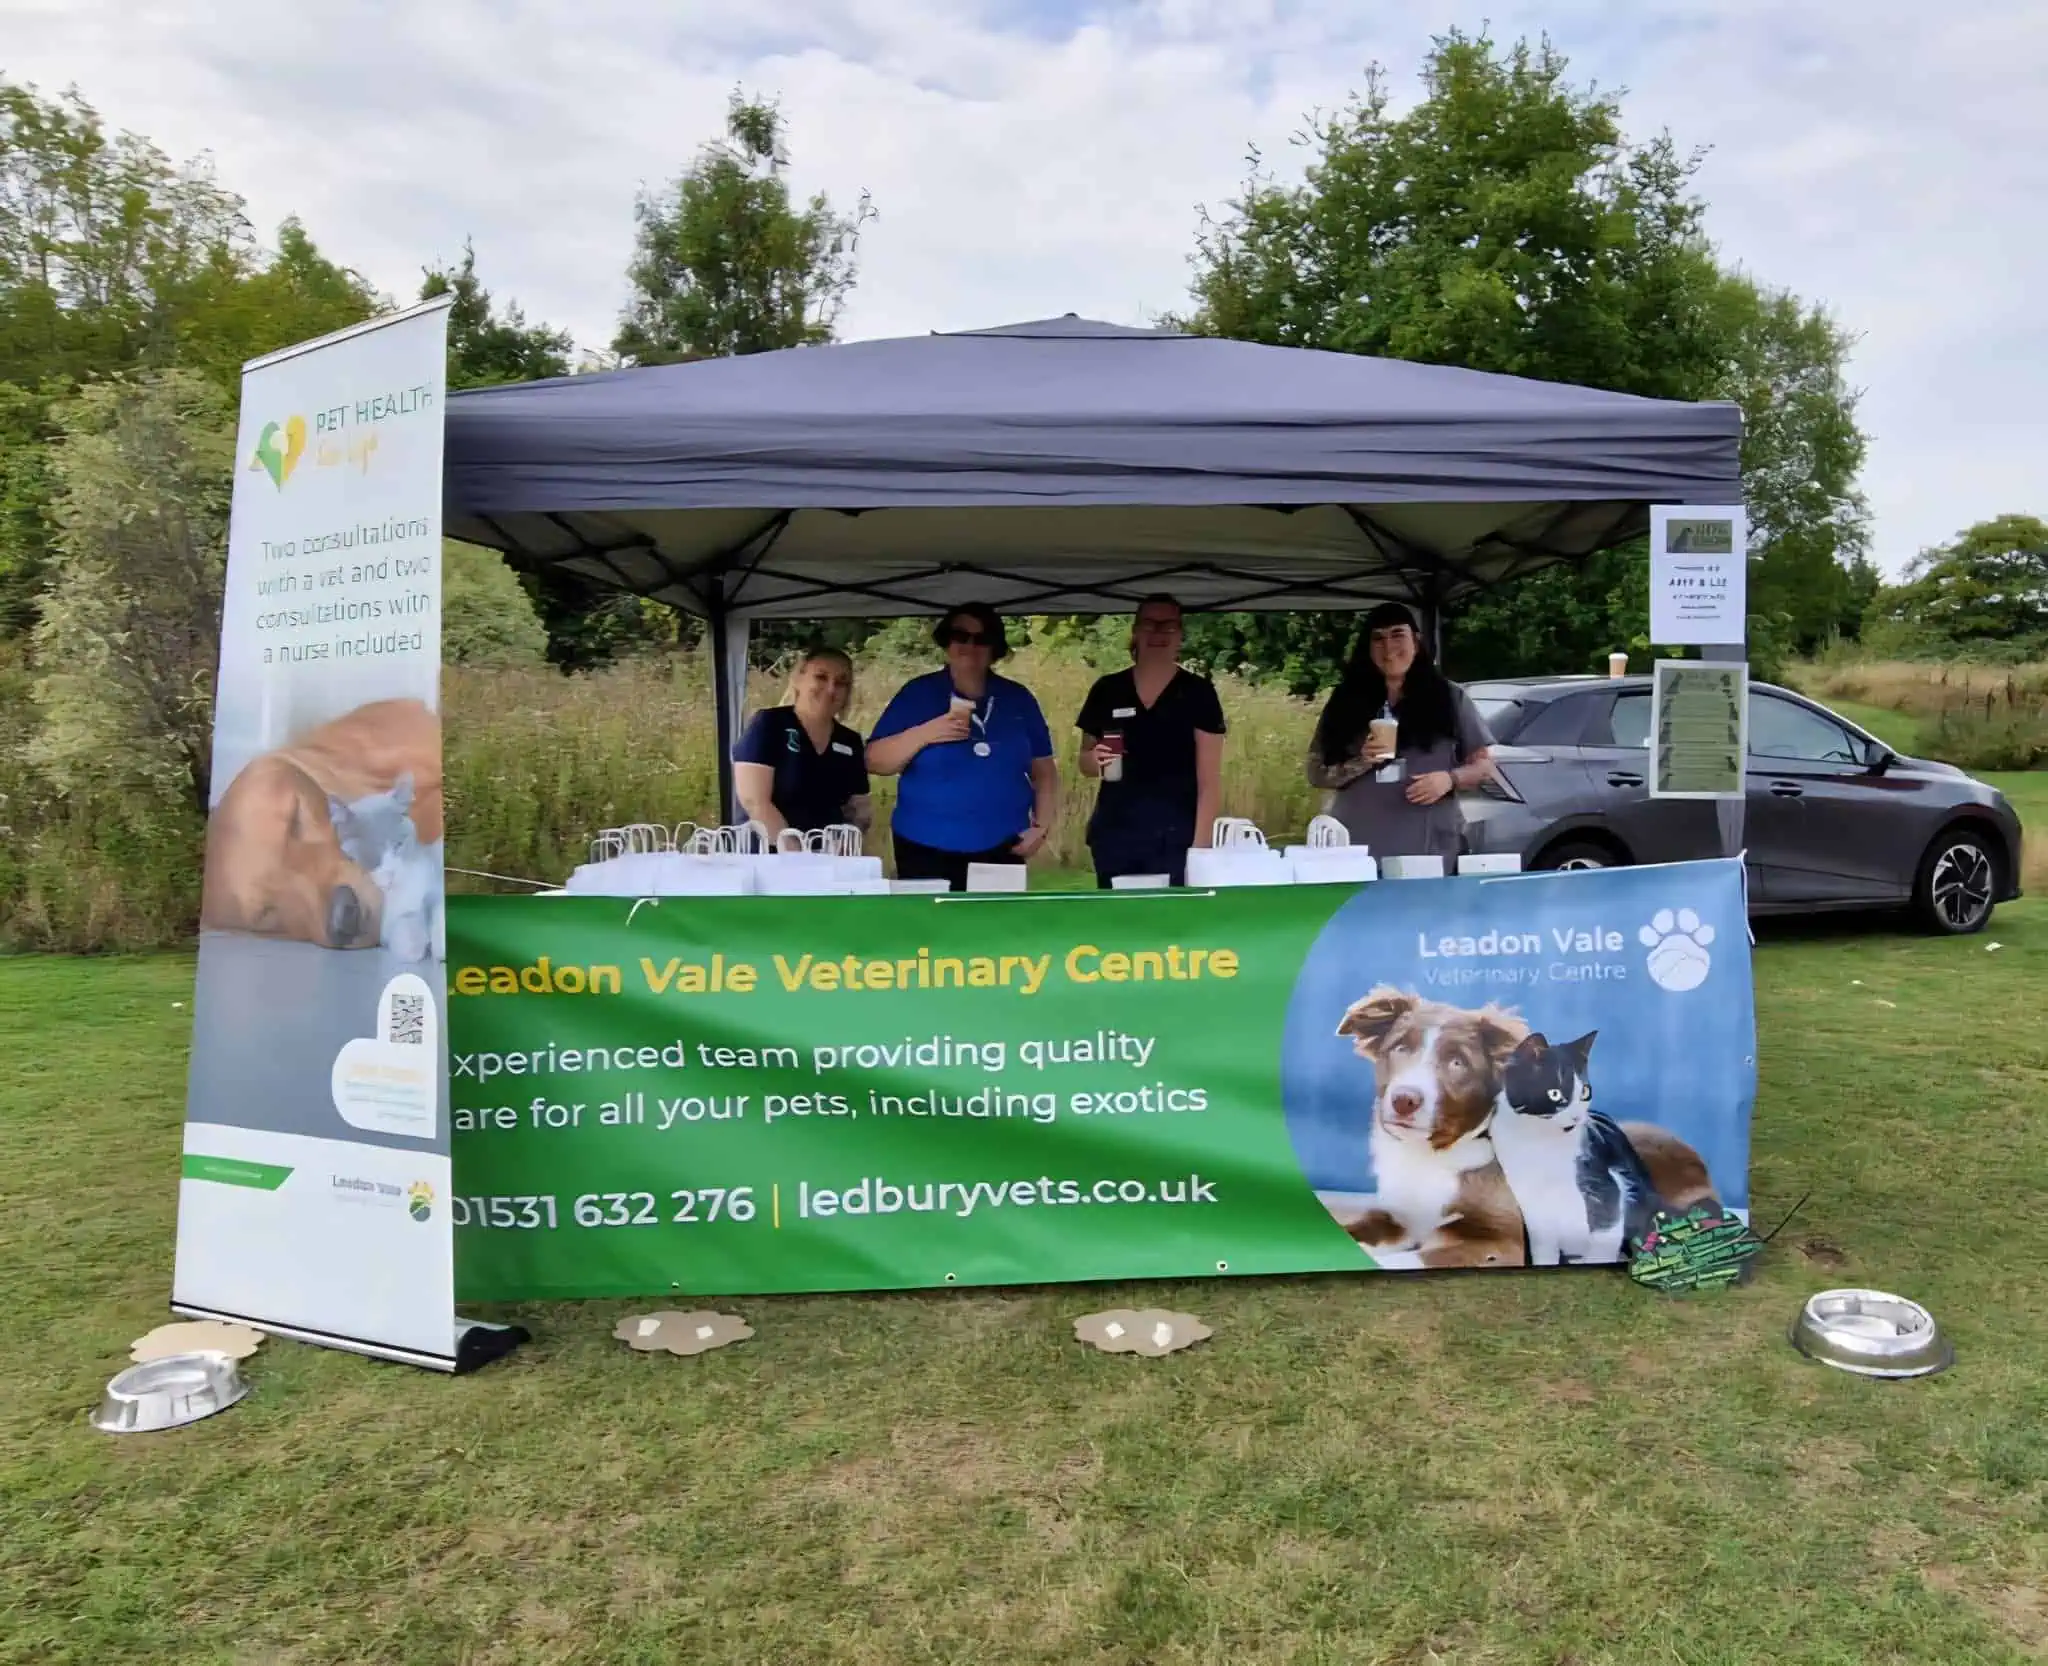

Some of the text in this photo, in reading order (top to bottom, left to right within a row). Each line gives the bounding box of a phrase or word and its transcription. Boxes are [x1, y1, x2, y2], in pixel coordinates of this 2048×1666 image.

[315, 405, 350, 434] PET
[261, 517, 429, 562] Two consultations
[257, 556, 432, 596] with a vet and two
[256, 590, 432, 630] consultations with
[263, 629, 424, 664] a nurse included
[1418, 925, 1624, 959] Leadon Vale
[447, 944, 1241, 996] eadon Vale Veterinary Centre
[1423, 961, 1627, 987] Veterinary Centre
[448, 1039, 685, 1084] xperienced
[697, 1043, 800, 1070] team
[813, 1034, 1007, 1076] providing
[1018, 1030, 1156, 1071] quality
[454, 1081, 1209, 1131] are for all your pets, including exotics
[452, 1174, 1219, 1230] 01531 632 276 ledburyvets.co.uk
